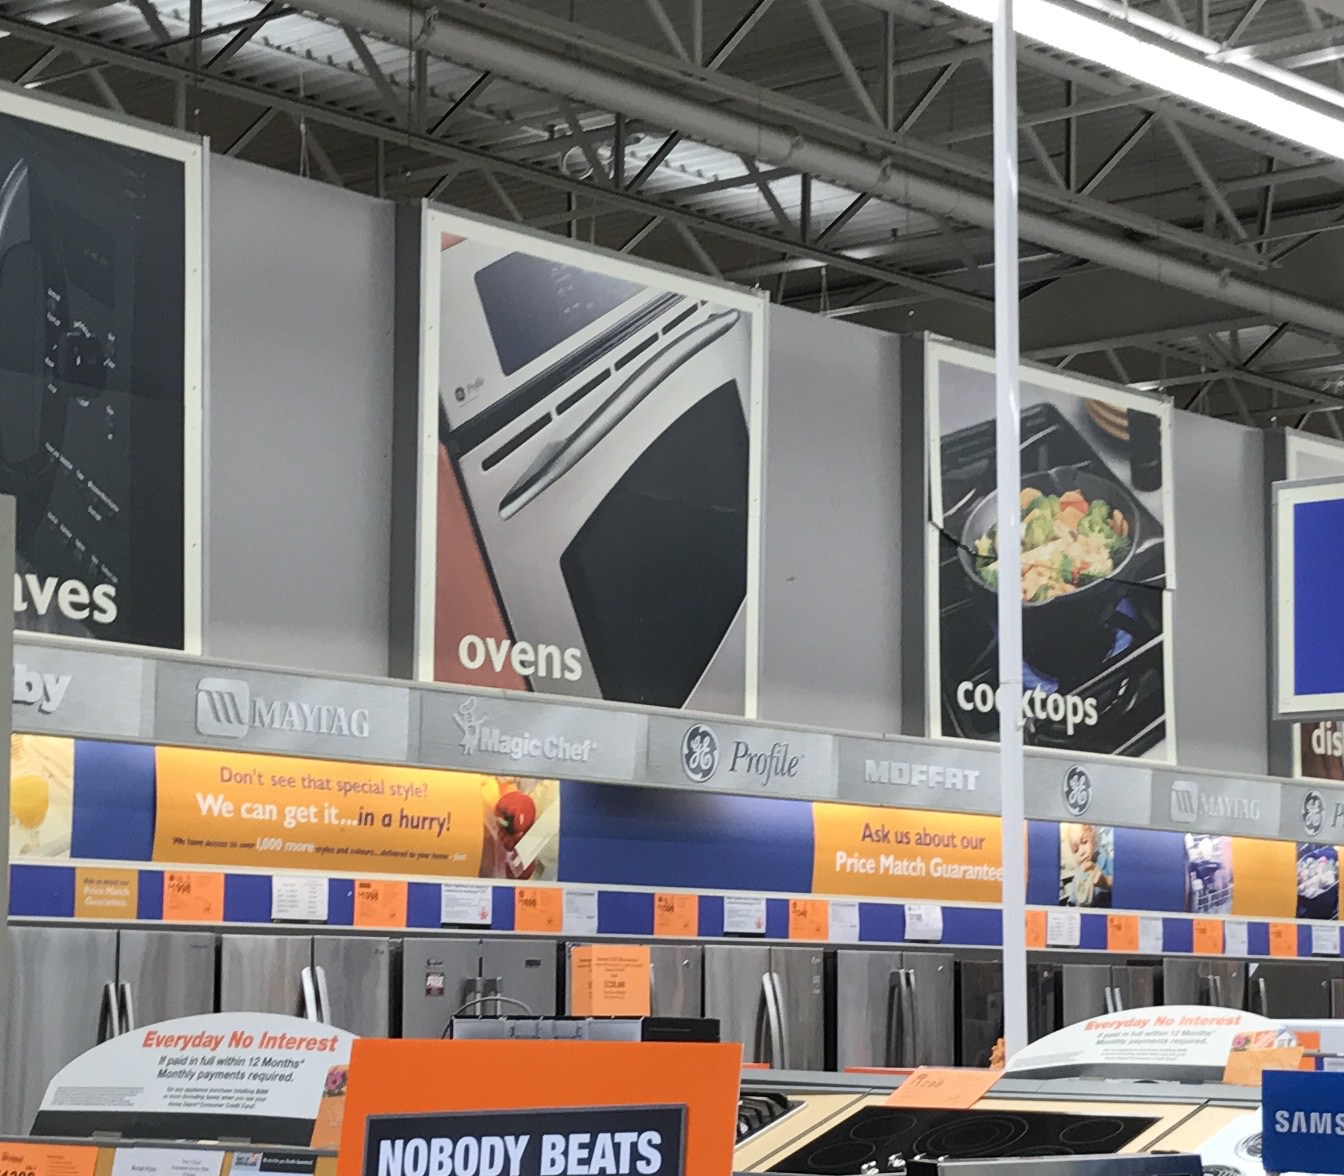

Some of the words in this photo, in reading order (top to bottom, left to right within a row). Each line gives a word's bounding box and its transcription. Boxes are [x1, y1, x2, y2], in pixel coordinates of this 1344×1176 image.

[458, 633, 583, 682] ovens
[252, 697, 370, 740] MAYTAG
[957, 680, 1098, 736] coktops
[480, 726, 541, 762] Magic
[543, 733, 593, 763] Chef
[729, 741, 800, 786] Profile
[864, 759, 979, 791] MOFFAT
[220, 766, 264, 785] Don't
[271, 774, 296, 788] see
[301, 773, 332, 791] that
[337, 777, 385, 797] special
[389, 781, 429, 800] style?
[195, 791, 234, 818] We
[240, 802, 277, 821] can
[283, 802, 318, 829] get
[381, 812, 392, 827] a
[399, 807, 452, 838] hurry!
[1199, 796, 1260, 821] MAYTAG
[861, 822, 891, 844] Ask
[895, 830, 911, 845] us
[915, 827, 957, 849] about
[960, 834, 986, 850] our
[835, 850, 876, 874] Price
[879, 853, 925, 877] Match
[1084, 1017, 1151, 1032] Everyday
[1154, 1016, 1175, 1027] No
[1179, 1014, 1243, 1026] Interest
[142, 1030, 225, 1051] Everyday
[228, 1030, 254, 1048] No
[258, 1031, 339, 1052] Interest
[157, 1068, 196, 1081] Monthly
[197, 1069, 246, 1083] payments
[247, 1071, 295, 1084] required.
[166, 1055, 189, 1068] paid
[189, 1056, 198, 1066] in
[199, 1055, 216, 1067] full
[216, 1056, 246, 1067] within
[247, 1057, 260, 1068] 12
[541, 1130, 663, 1176] BEATS
